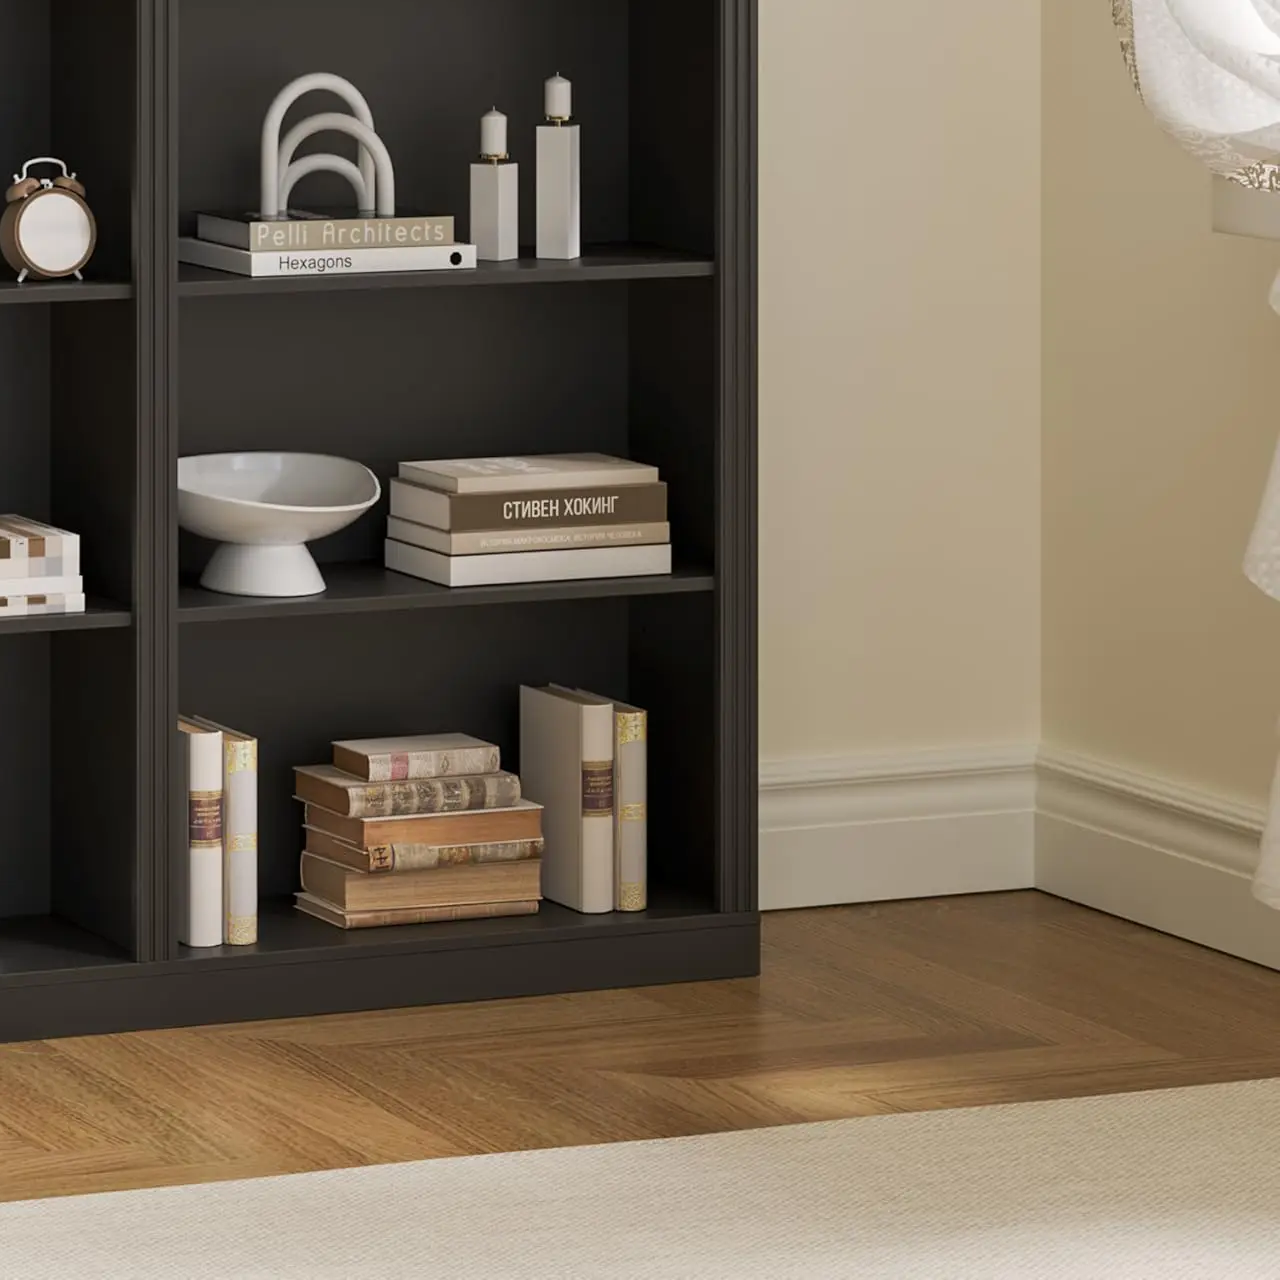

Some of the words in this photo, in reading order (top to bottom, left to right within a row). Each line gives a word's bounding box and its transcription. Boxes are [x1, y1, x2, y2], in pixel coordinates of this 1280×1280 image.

[257, 223, 308, 247] Pelli
[323, 222, 445, 244] Architects
[279, 255, 352, 273] Hexagons
[503, 499, 559, 520] СТИВЕН
[563, 496, 620, 517] ХОКИНГ
